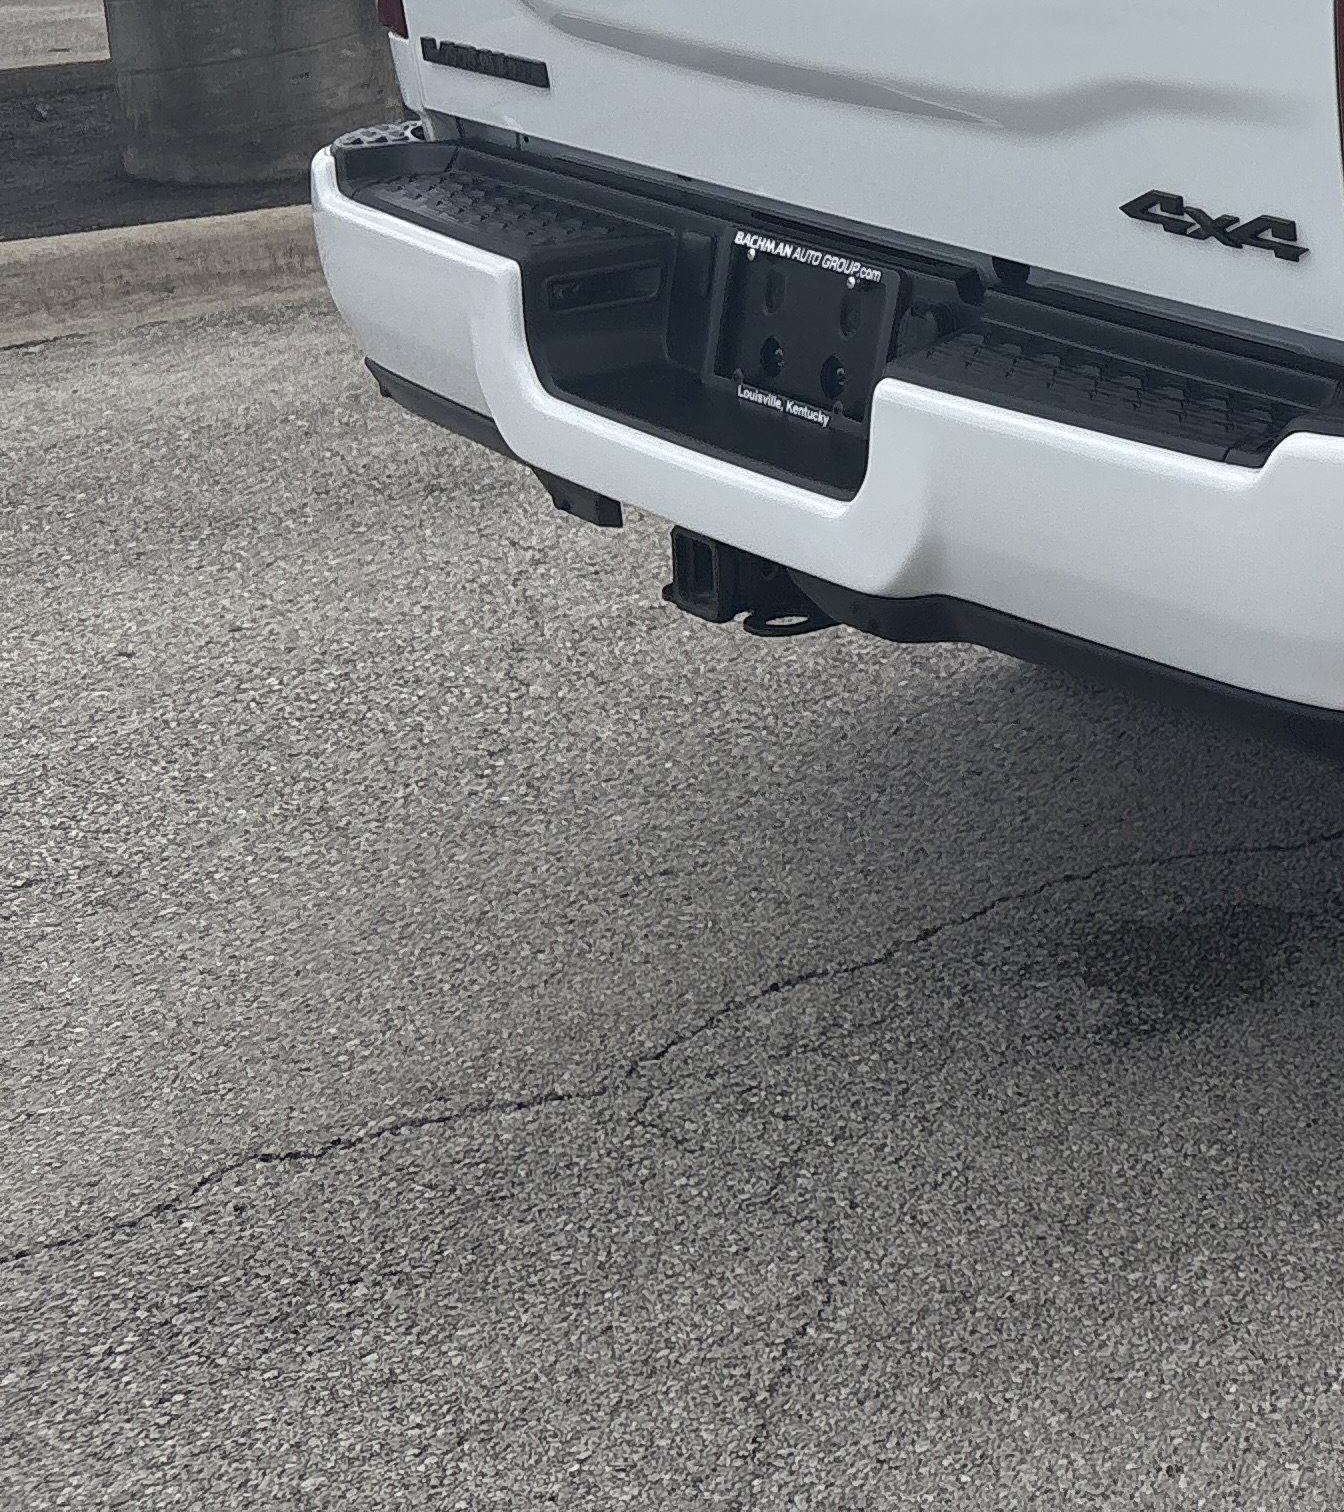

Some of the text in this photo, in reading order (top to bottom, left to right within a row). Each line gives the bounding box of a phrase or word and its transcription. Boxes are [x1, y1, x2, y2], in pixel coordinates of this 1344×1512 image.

[734, 230, 882, 283] BACHMAN AUTO GROUP.com
[786, 399, 830, 428] Kentucky
